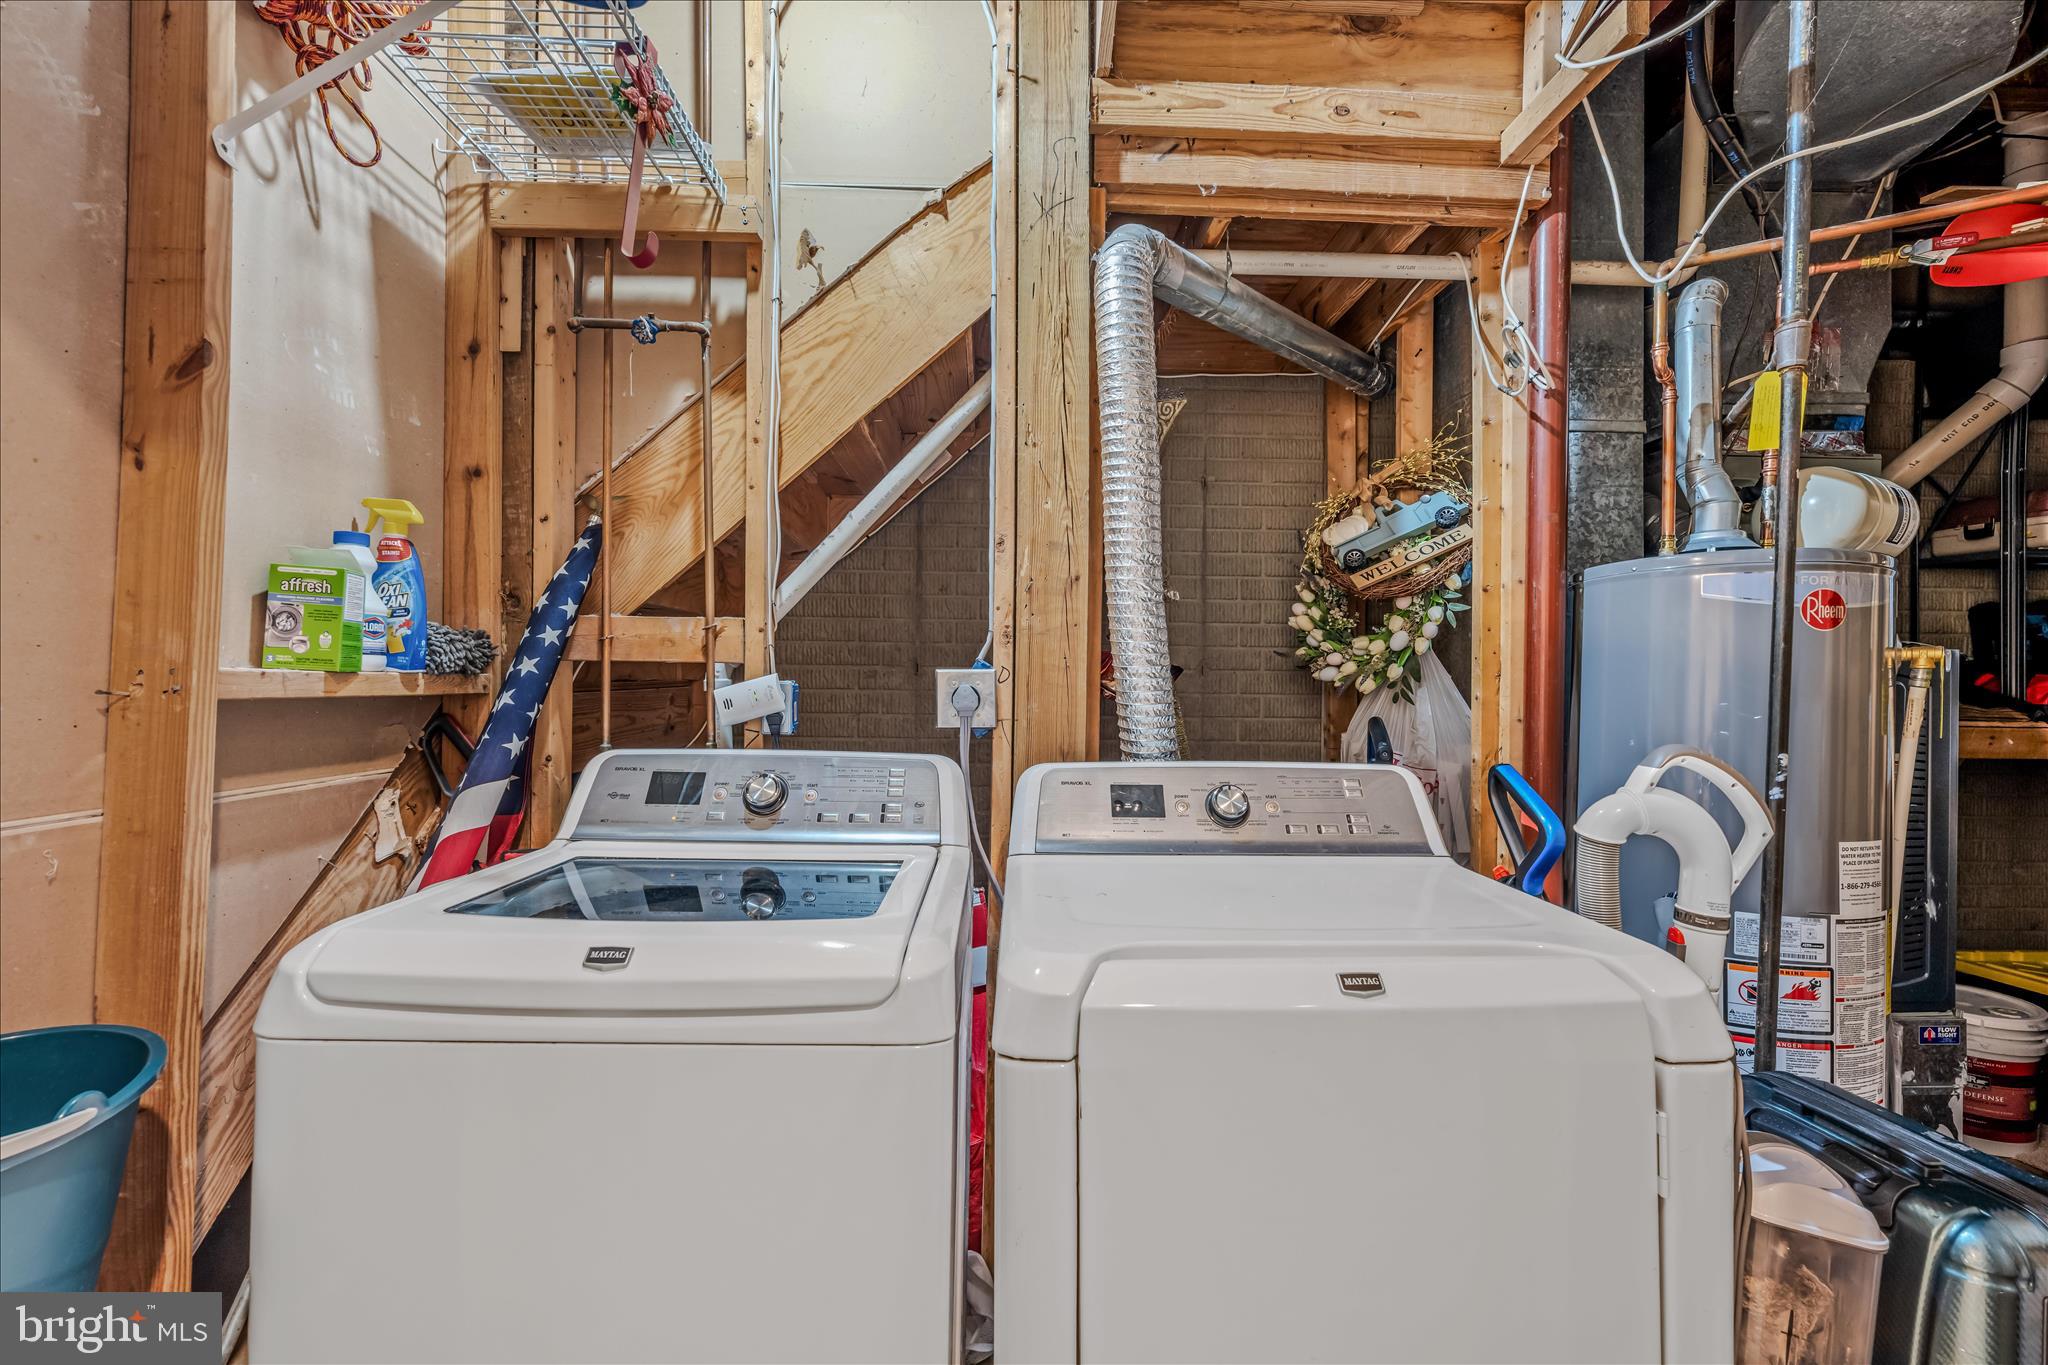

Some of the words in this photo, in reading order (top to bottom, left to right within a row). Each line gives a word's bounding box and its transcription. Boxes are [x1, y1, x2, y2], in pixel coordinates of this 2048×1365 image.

[1360, 530, 1466, 582] WELCOME
[280, 577, 332, 594] affresh
[377, 582, 402, 596] OXI
[384, 593, 409, 608] EAN
[1806, 589, 1845, 625] Rheem
[590, 950, 627, 959] MAYTAG
[1343, 977, 1379, 986] MAYTAG
[1964, 1090, 2005, 1103] DEFENSE
